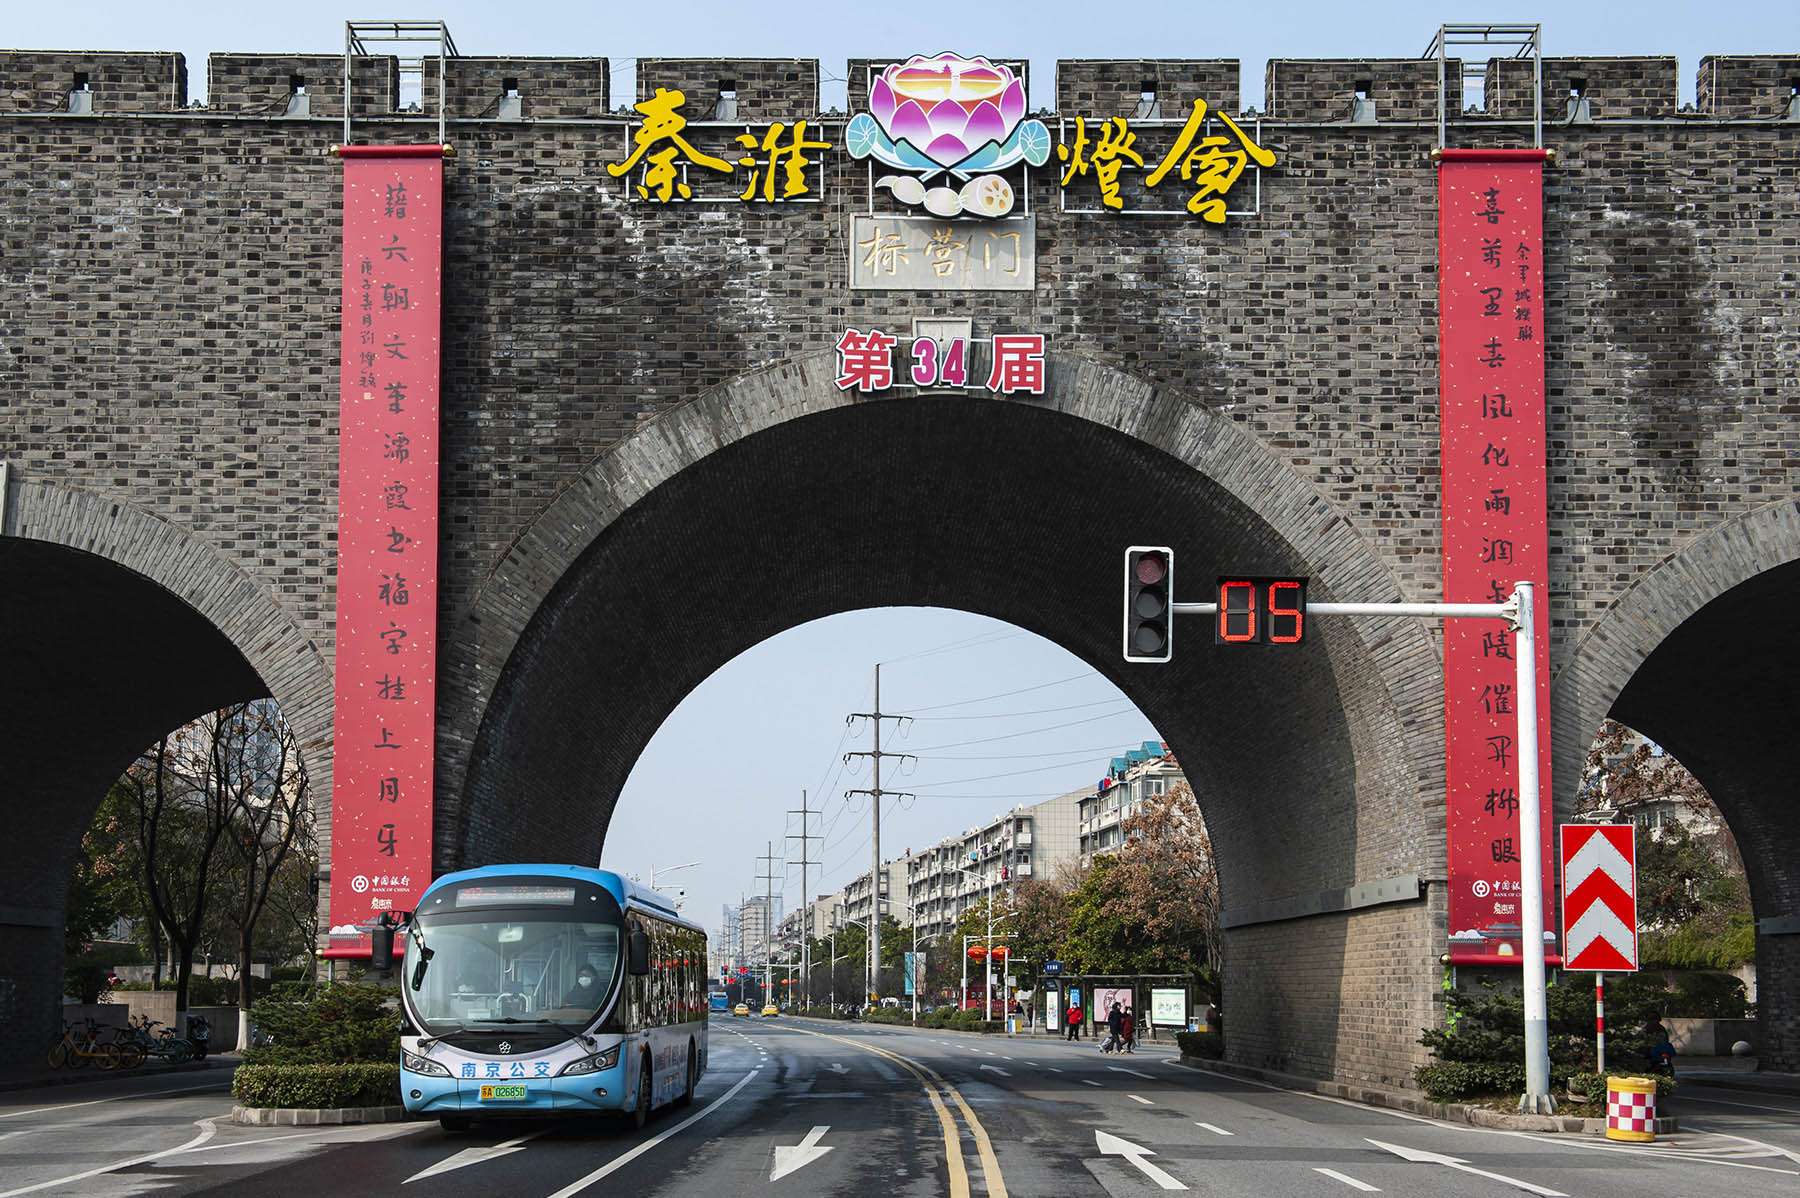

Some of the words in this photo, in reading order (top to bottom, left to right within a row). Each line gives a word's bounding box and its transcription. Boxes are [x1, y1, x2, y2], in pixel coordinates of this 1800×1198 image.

[607, 87, 831, 203] 秦淮
[1220, 581, 1303, 643] 05
[462, 1062, 550, 1078] 南京公交
